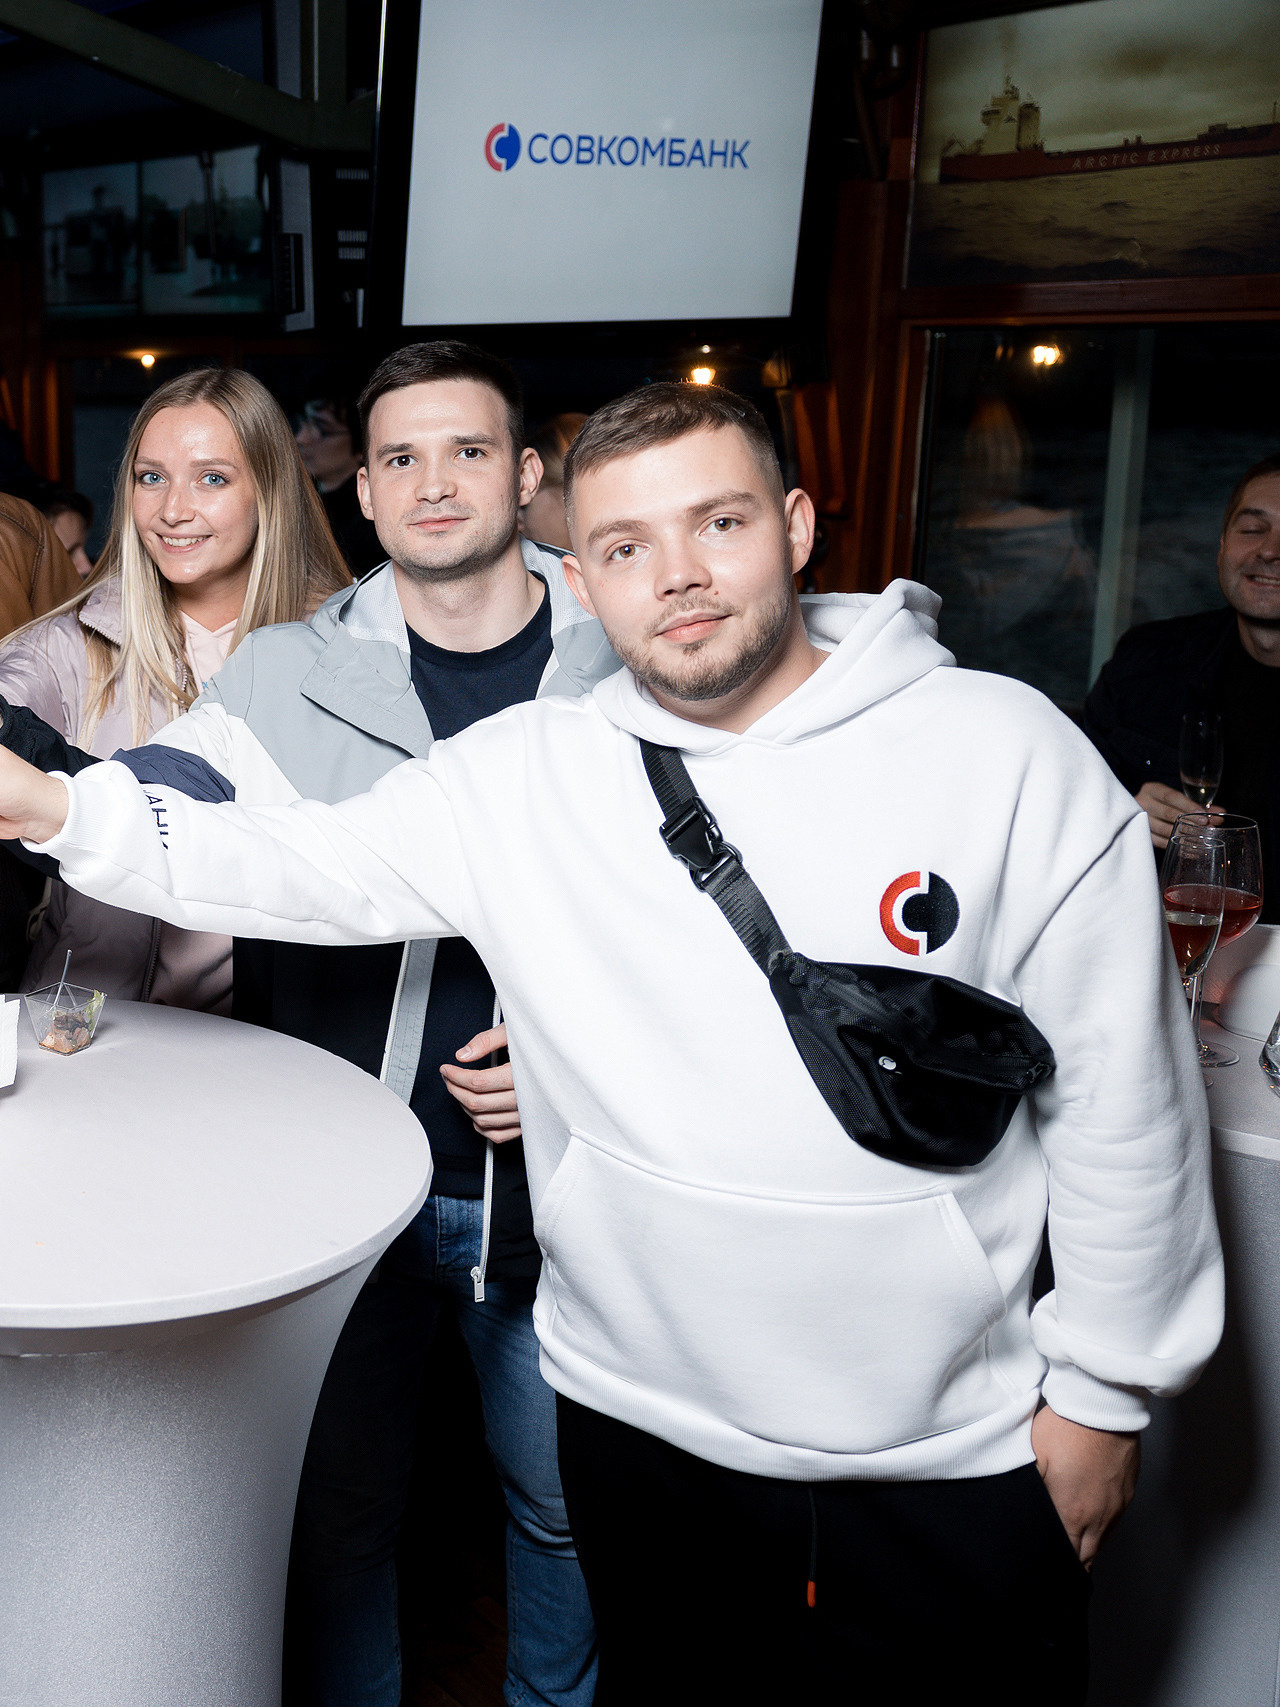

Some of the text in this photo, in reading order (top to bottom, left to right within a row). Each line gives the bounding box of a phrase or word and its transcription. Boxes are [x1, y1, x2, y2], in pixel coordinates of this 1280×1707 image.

[528, 133, 750, 169] СОВКОМБАНК
[1072, 143, 1221, 170] ARCTIC EXPRESS
